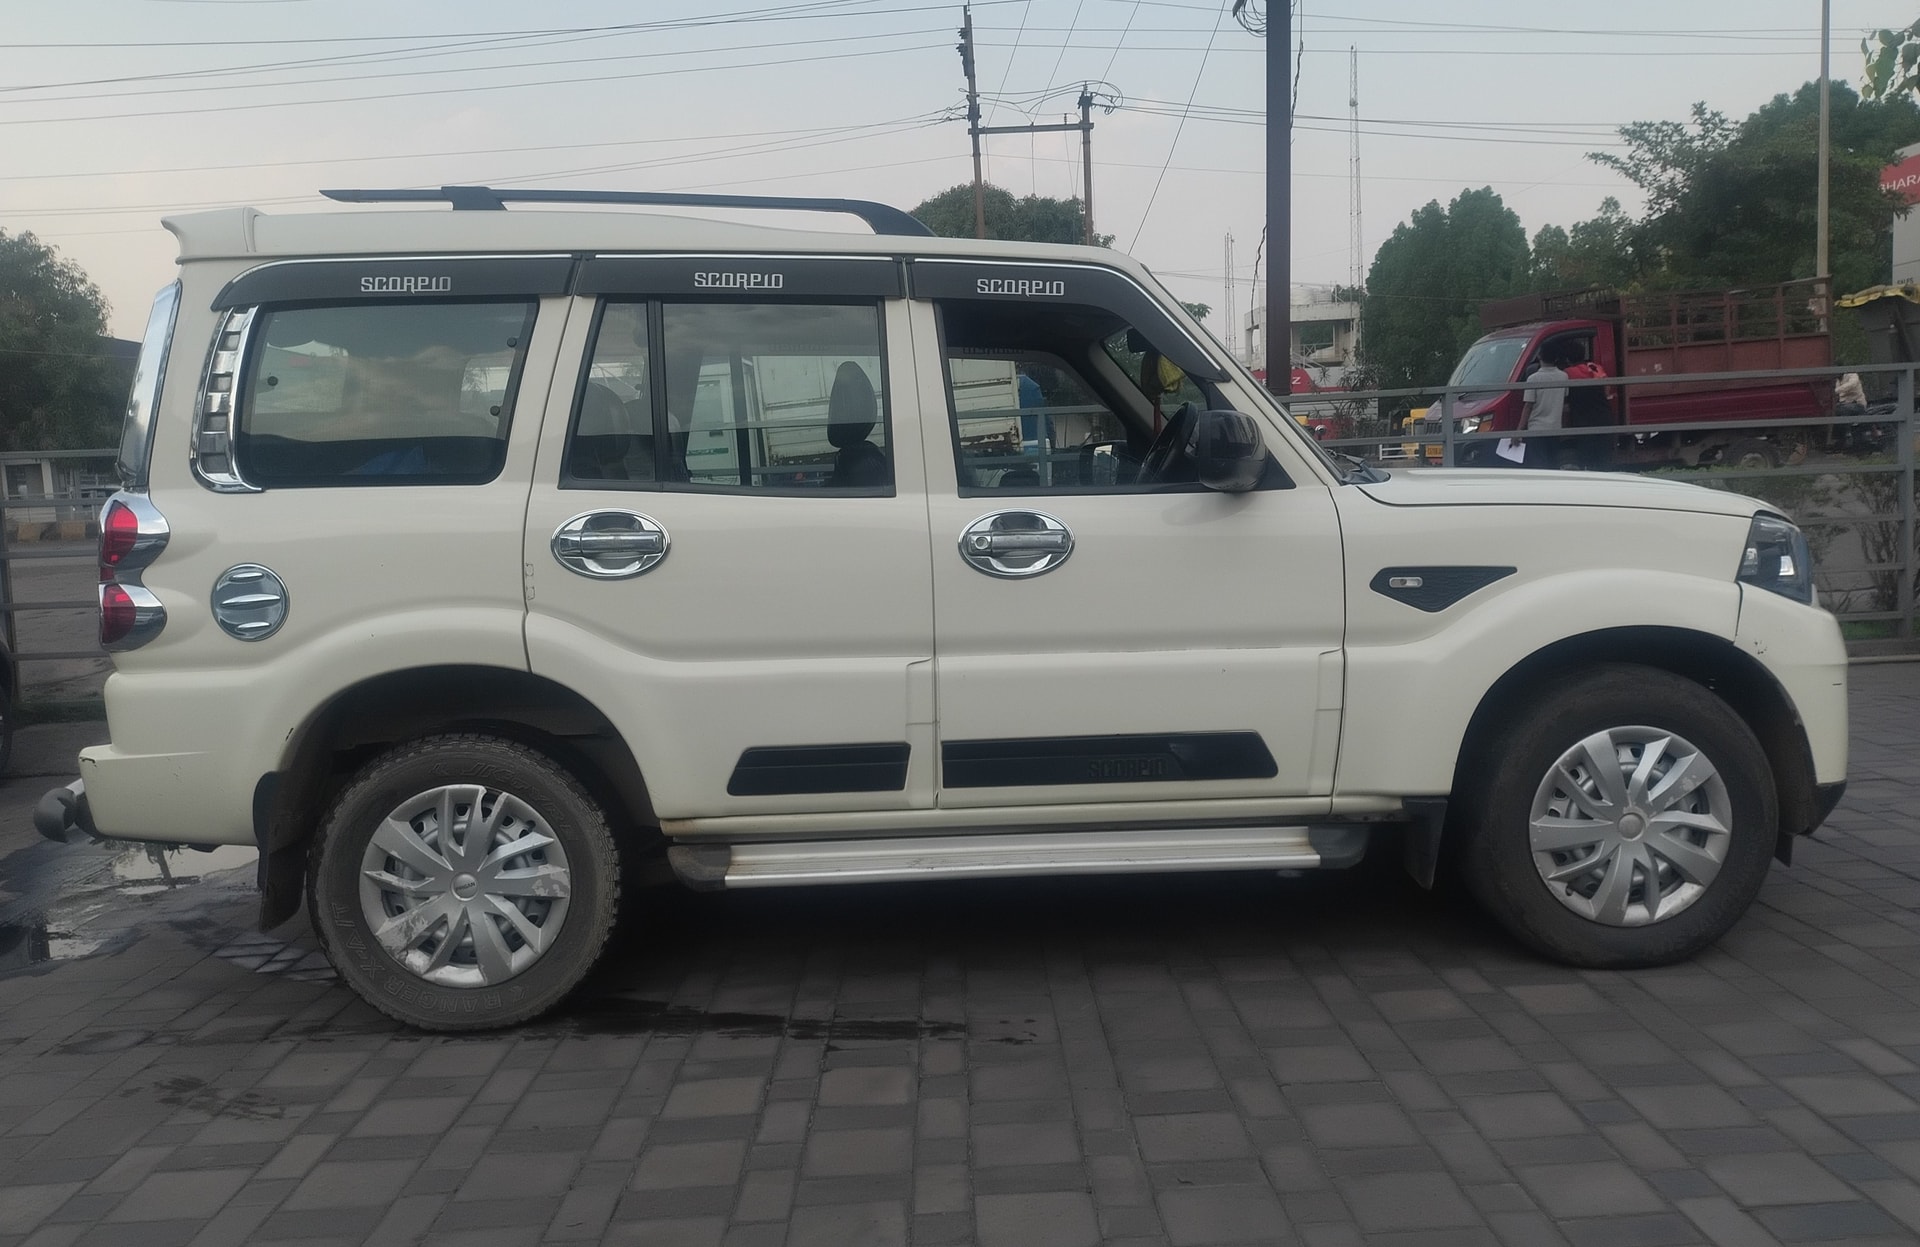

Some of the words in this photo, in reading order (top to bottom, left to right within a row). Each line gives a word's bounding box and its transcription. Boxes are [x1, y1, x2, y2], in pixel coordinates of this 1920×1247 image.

[361, 276, 451, 294] SCORPIO
[694, 272, 783, 290] SCORPIO
[977, 278, 1064, 297] SCORPIO
[383, 975, 502, 1012] RANGER
